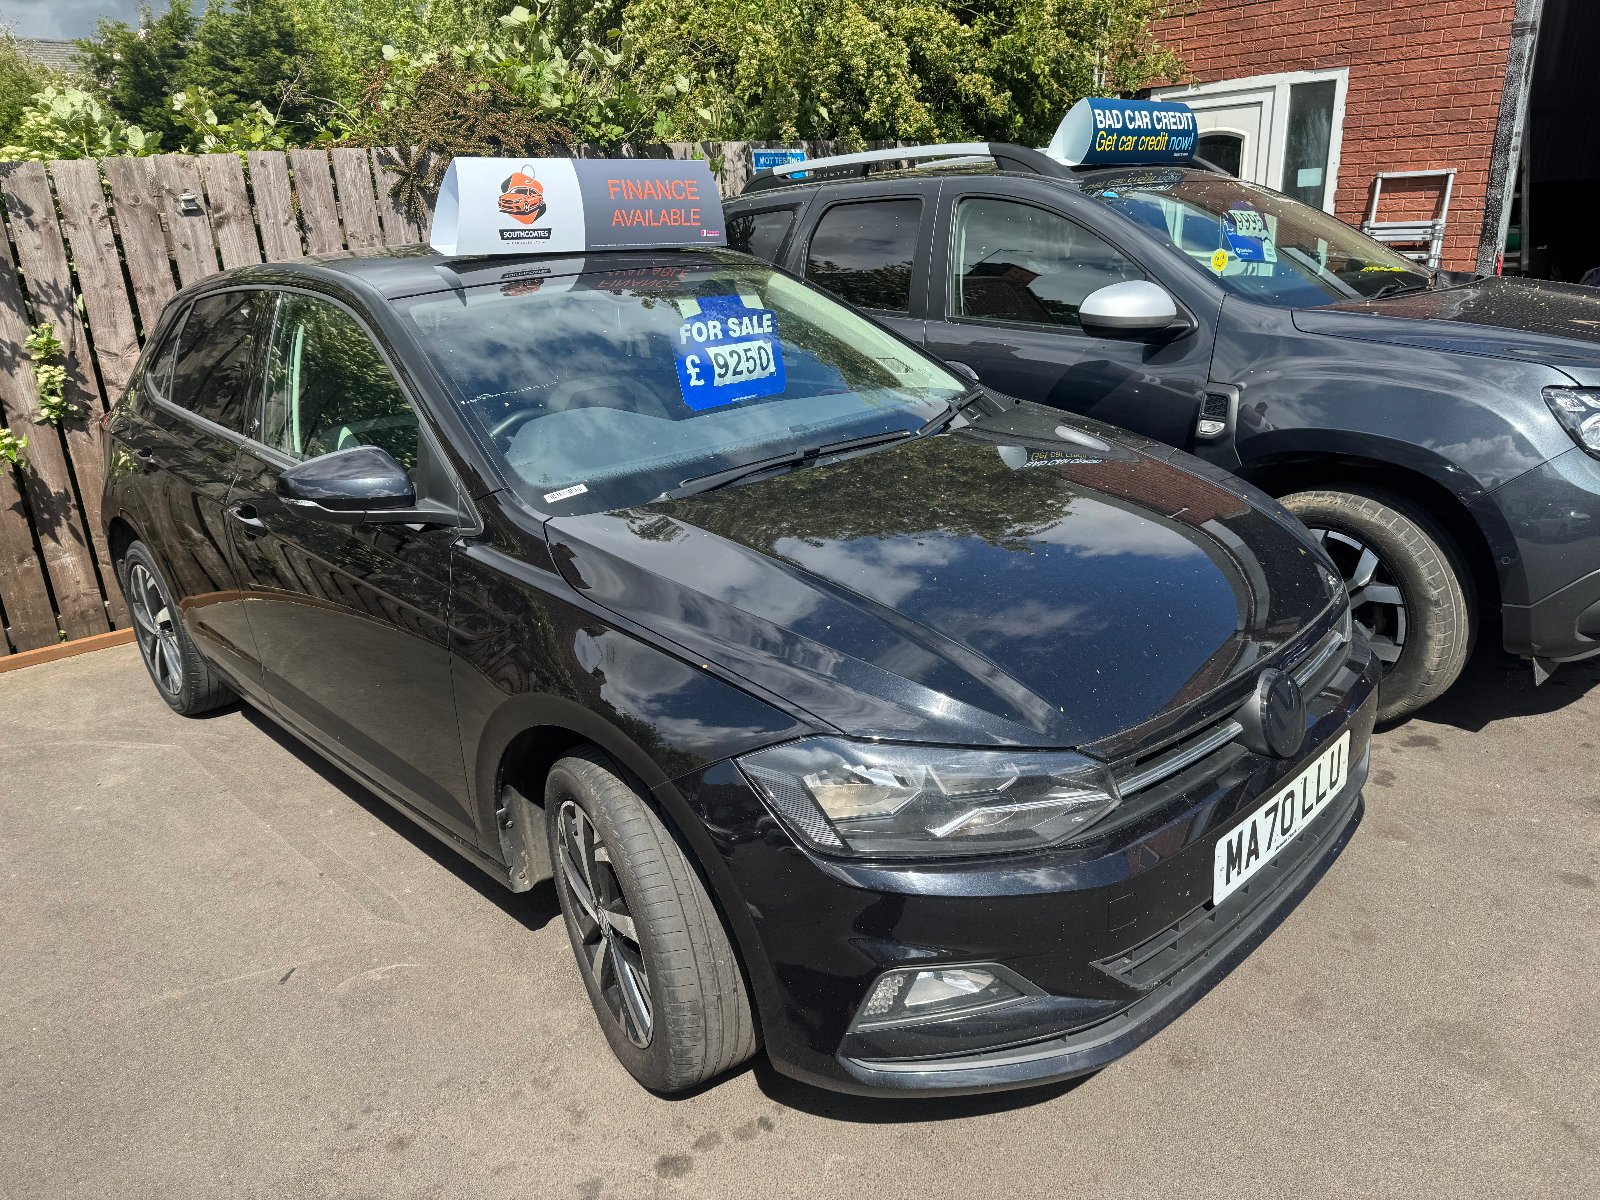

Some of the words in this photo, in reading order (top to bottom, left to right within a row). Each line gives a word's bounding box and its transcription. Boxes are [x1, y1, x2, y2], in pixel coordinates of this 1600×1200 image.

[1094, 109, 1123, 129] BAD
[1125, 110, 1152, 130] CAR
[1153, 111, 1193, 130] CREDIT
[1095, 130, 1118, 151] Get
[1118, 135, 1138, 151] car
[1138, 131, 1169, 151] credit
[1169, 132, 1194, 151] now!
[607, 179, 700, 200] FINANCE
[611, 208, 701, 227] AVAILABLE
[503, 230, 549, 239] SOUTHCOATES
[680, 320, 723, 345] FOR
[727, 314, 773, 338] SALE
[685, 355, 705, 386] £
[713, 345, 771, 379] 9250
[1225, 789, 1295, 887] MA70
[1301, 743, 1342, 820] LLU
